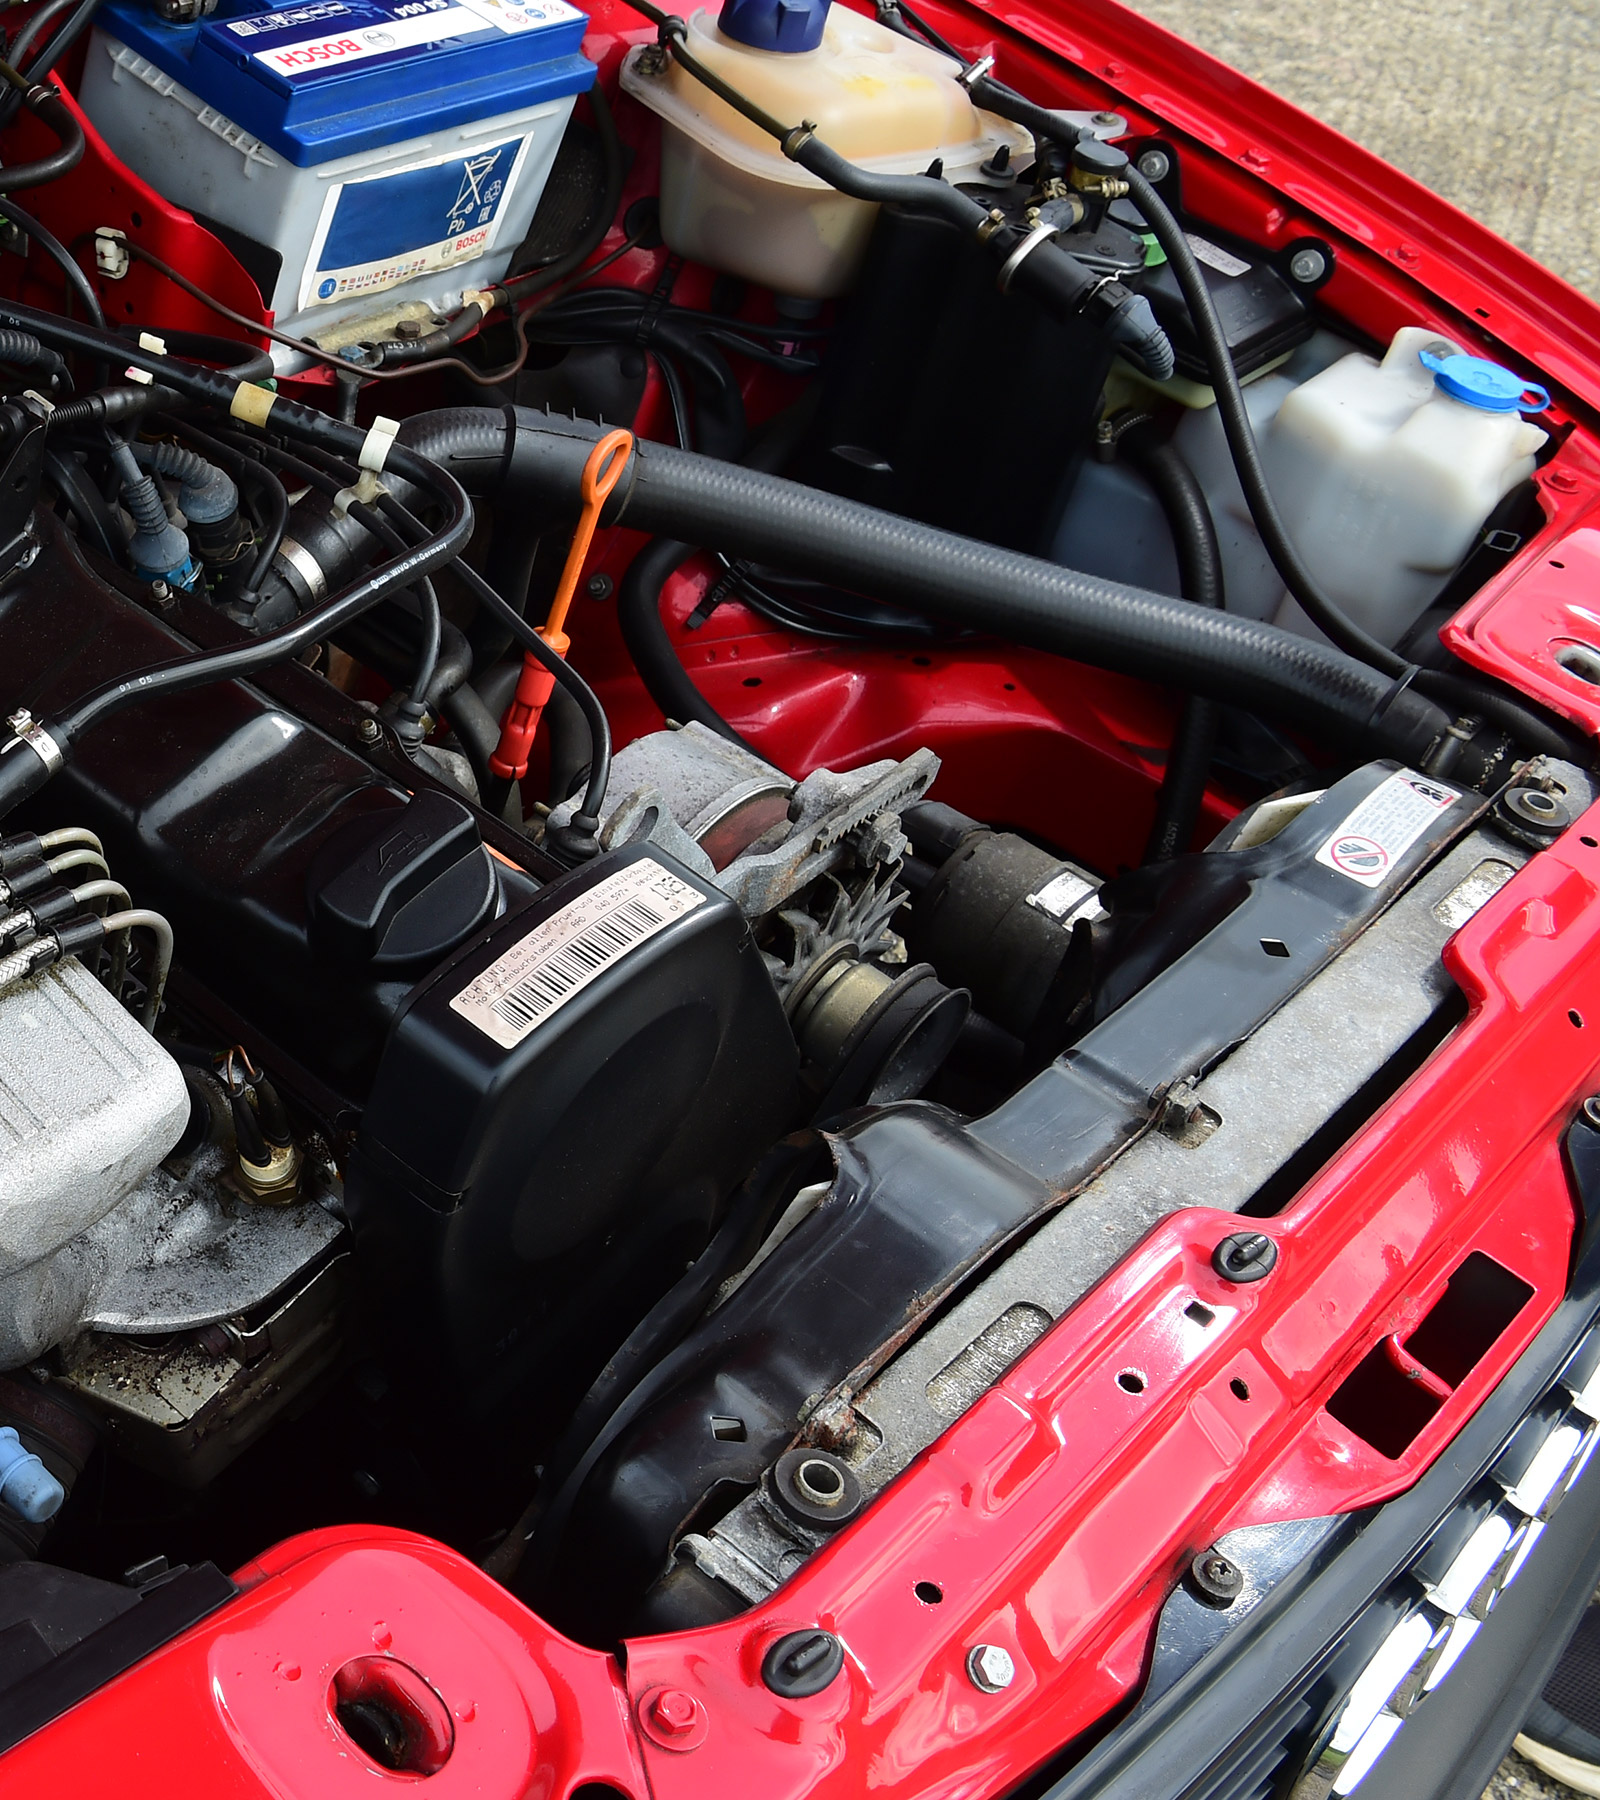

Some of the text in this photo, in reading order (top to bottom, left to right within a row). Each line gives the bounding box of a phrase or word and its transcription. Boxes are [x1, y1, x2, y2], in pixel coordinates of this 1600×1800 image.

[394, 2, 427, 18] 004
[275, 39, 362, 67] BOSCH
[447, 217, 466, 236] Pb
[455, 229, 488, 251] BOSCH
[390, 562, 410, 577] WIVO
[459, 958, 512, 1006] ACHTUNG!
[510, 947, 527, 960] Bei
[528, 926, 552, 946] allen
[475, 938, 559, 1006] Motorkennbuchstaben
